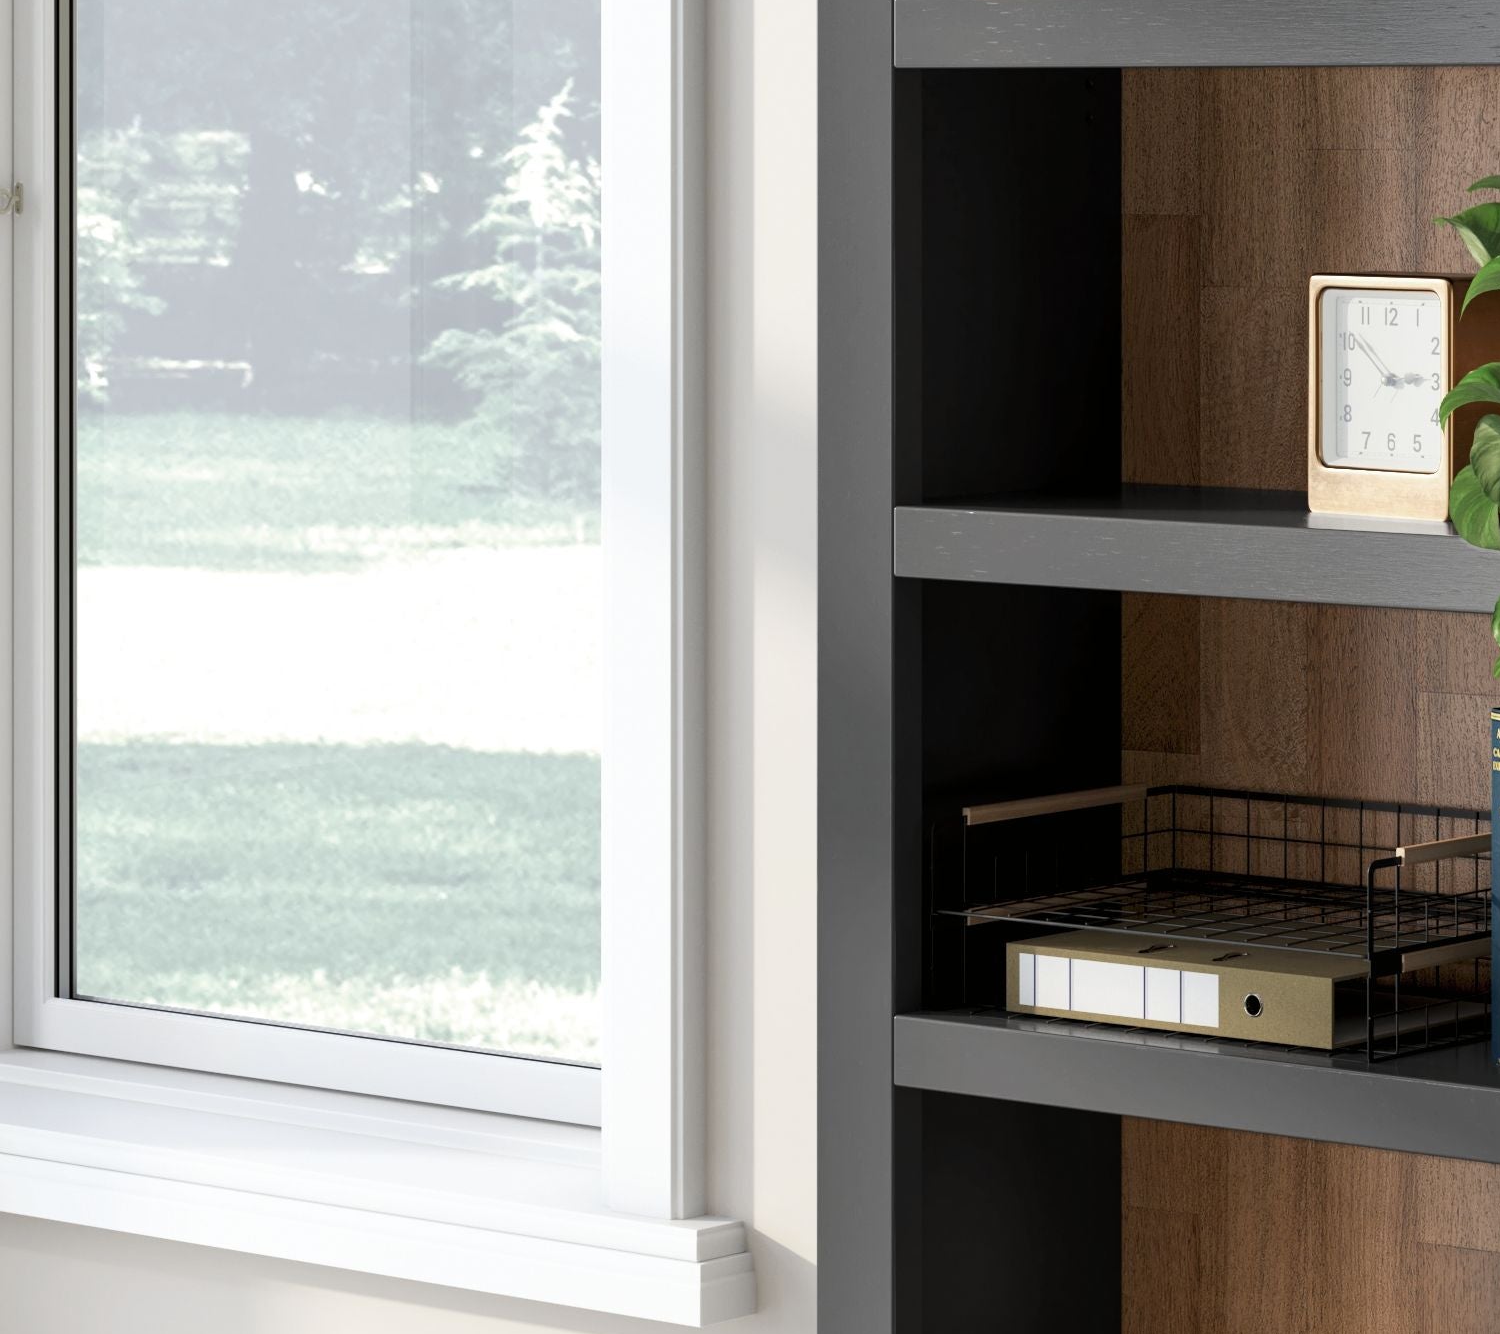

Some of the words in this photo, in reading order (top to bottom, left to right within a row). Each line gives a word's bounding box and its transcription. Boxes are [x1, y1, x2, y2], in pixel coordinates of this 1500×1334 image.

[1361, 306, 1370, 325] 11
[1384, 307, 1398, 326] 12
[1343, 332, 1356, 351] 10
[1431, 337, 1440, 355] 2
[1343, 368, 1352, 387] 9
[1431, 373, 1440, 391] 3
[1344, 405, 1352, 422] 8
[1431, 408, 1440, 426] 4
[1361, 432, 1371, 449] 7
[1387, 433, 1396, 451] 6
[1413, 435, 1422, 452] 5
